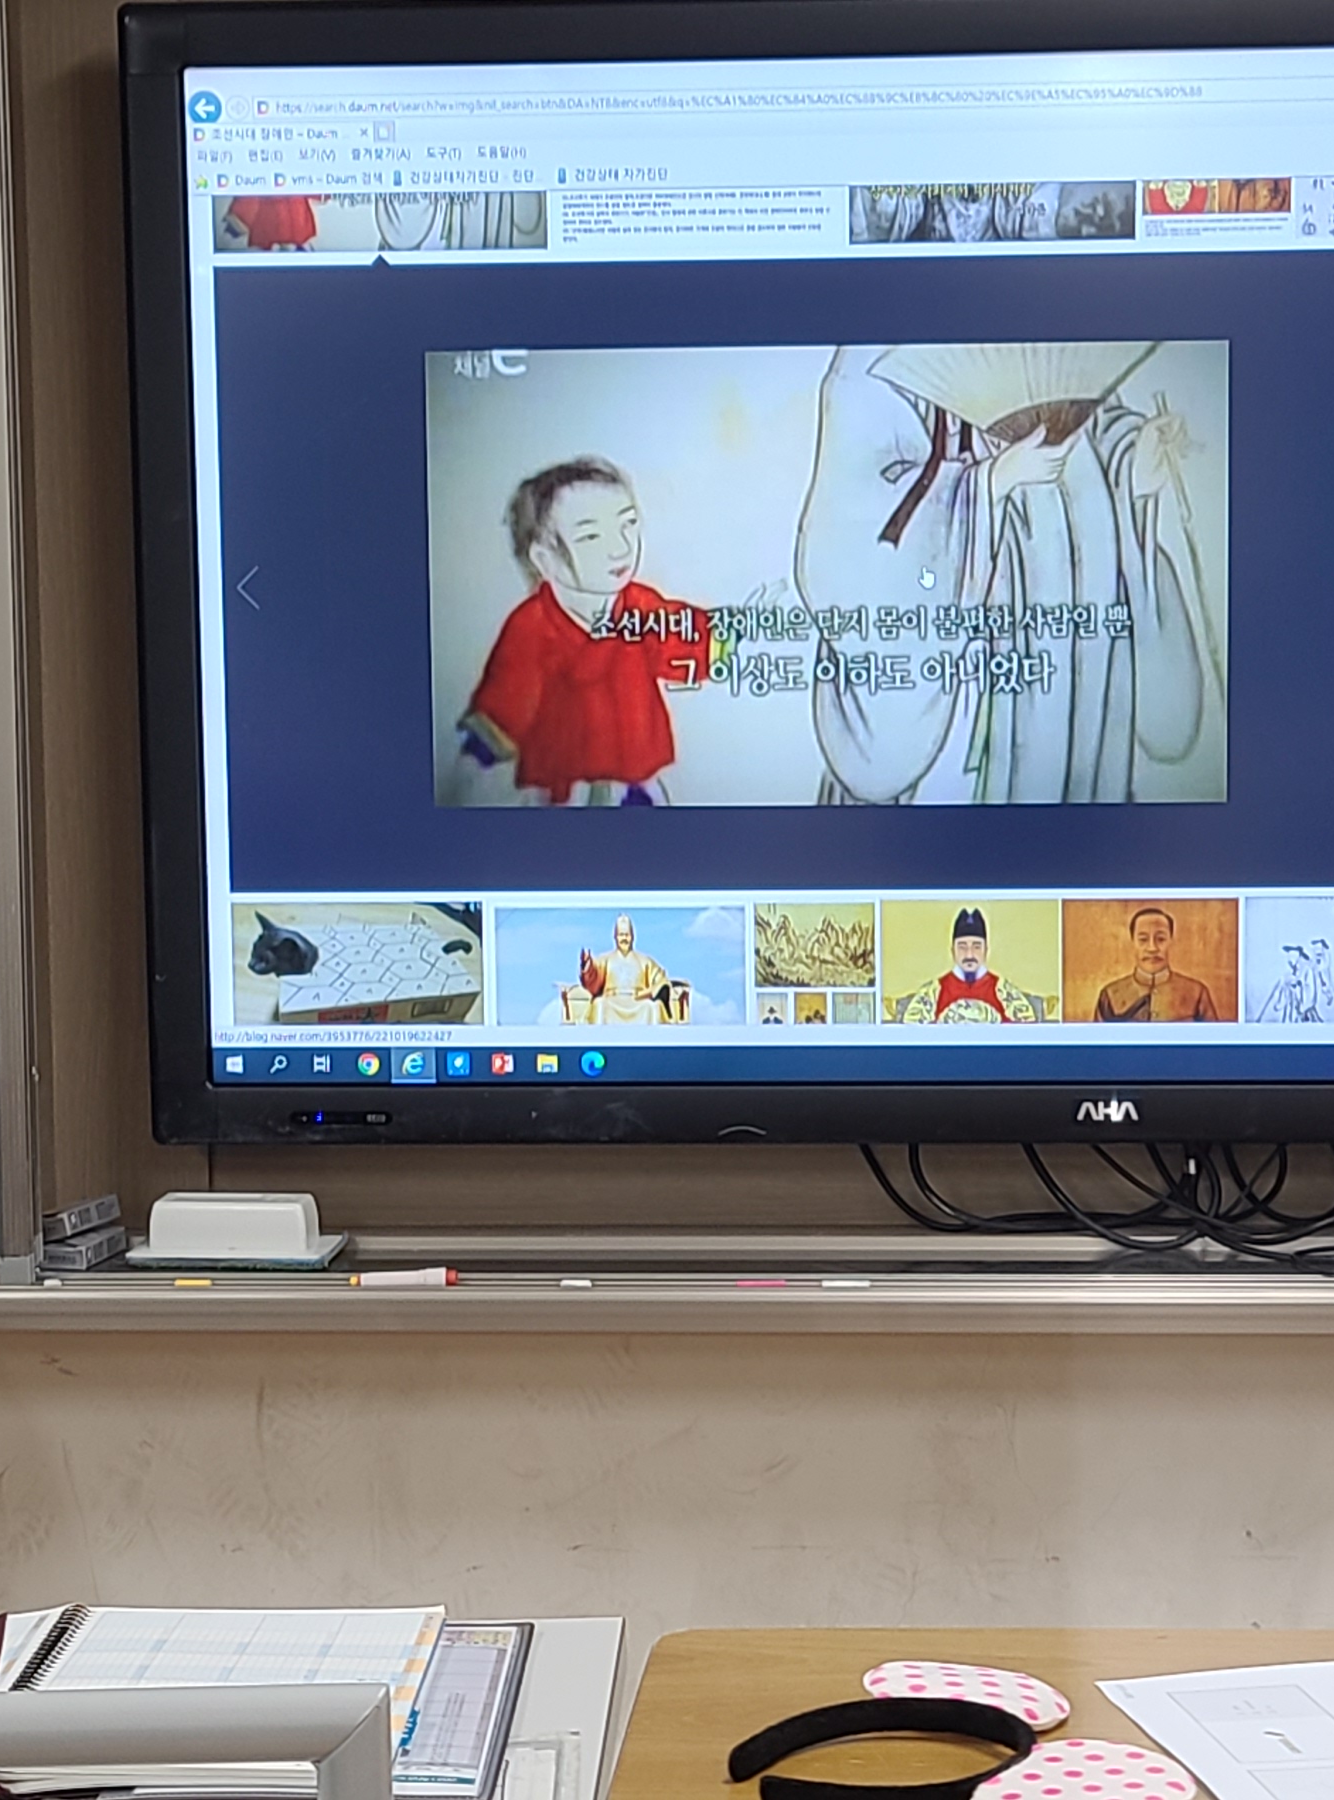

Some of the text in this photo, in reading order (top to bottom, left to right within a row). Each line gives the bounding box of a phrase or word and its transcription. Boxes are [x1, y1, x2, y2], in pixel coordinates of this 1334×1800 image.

[307, 127, 338, 140] Daum
[197, 146, 527, 163] 파일(F) 편집(E) 보기(V) 즐겨찾기(A) 도구(T) 도움말(H)
[236, 175, 266, 186] Daum
[326, 174, 358, 186] Daum
[589, 602, 1134, 644] 조선시대, 장애인은 단지 몸이 불편한 사람일 뿐
[665, 650, 1060, 698] 그 이상도 이하도 아니었다
[1076, 1100, 1139, 1122] AHA
